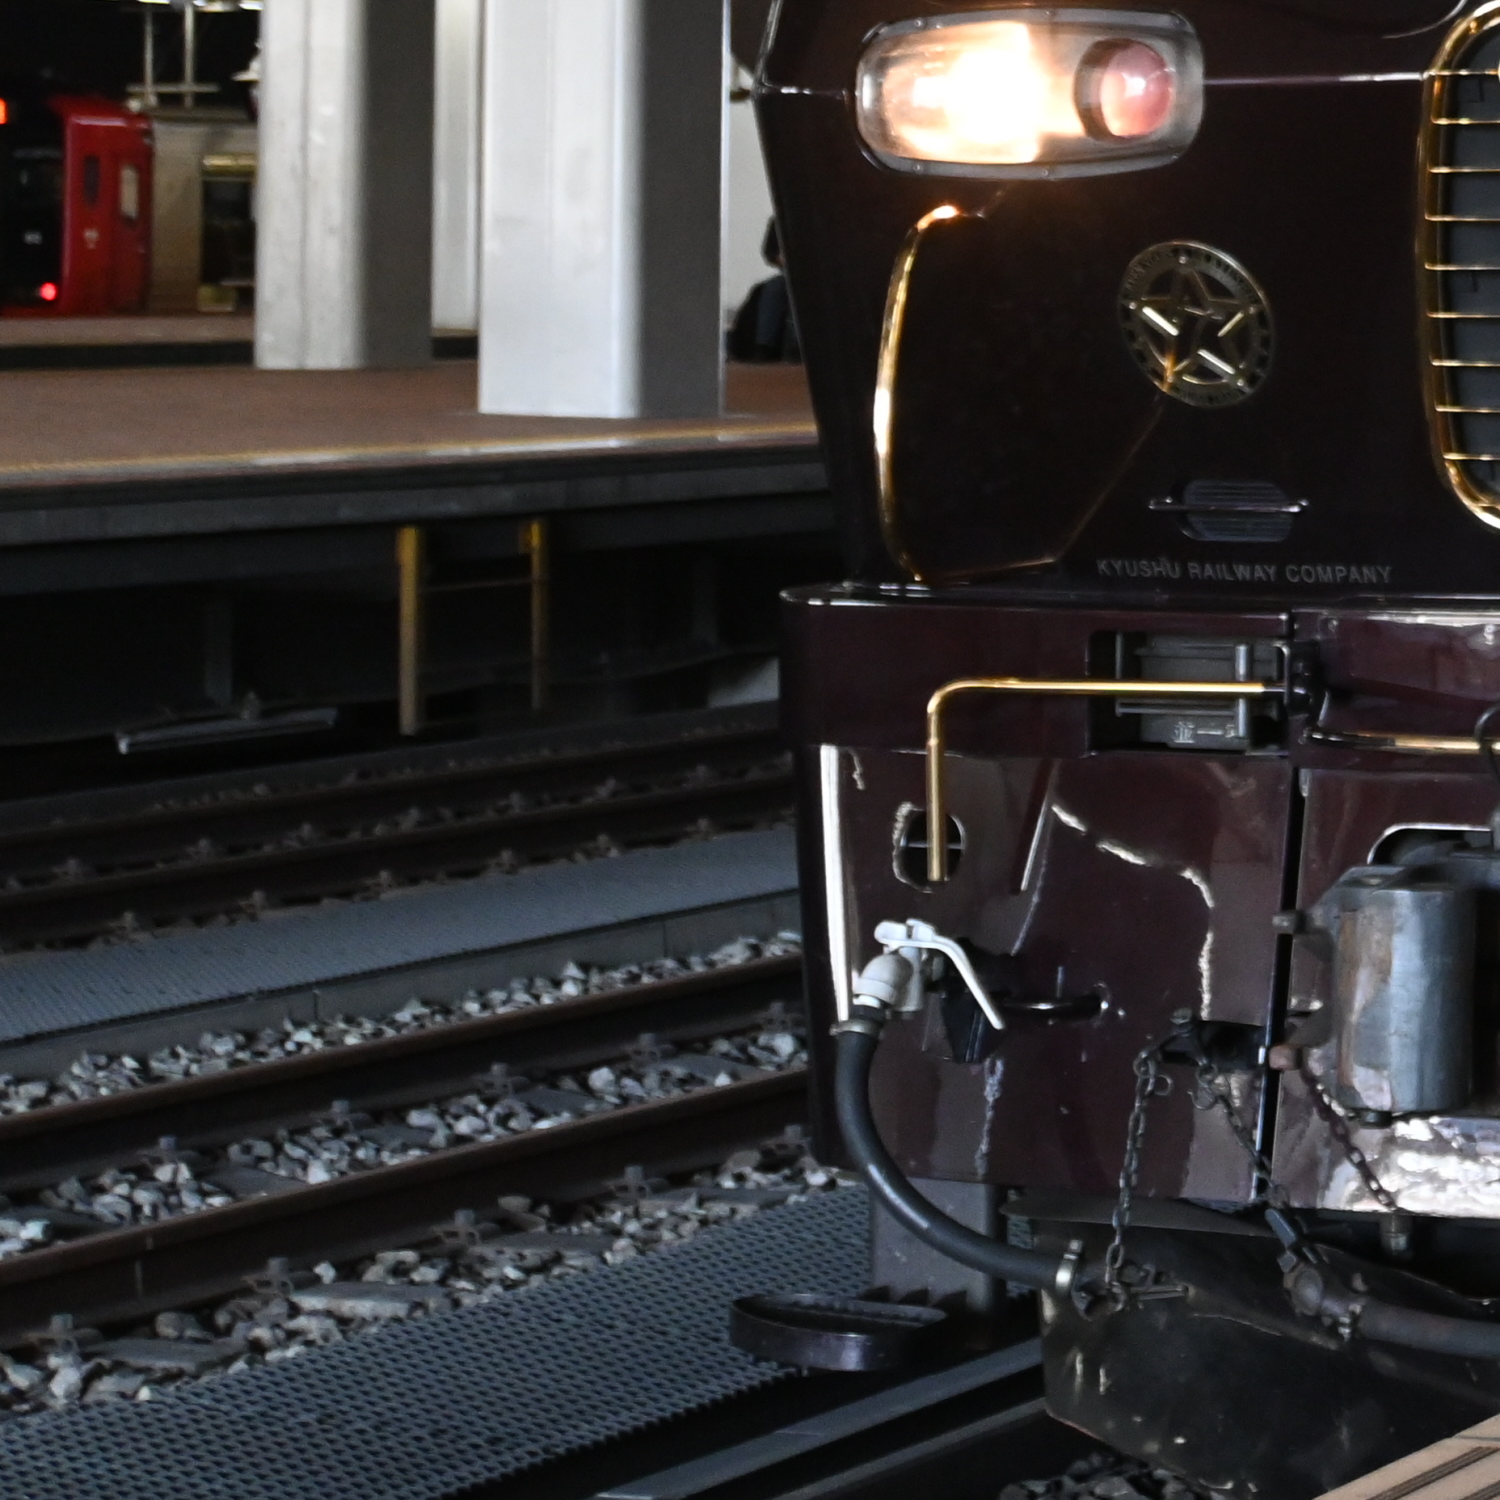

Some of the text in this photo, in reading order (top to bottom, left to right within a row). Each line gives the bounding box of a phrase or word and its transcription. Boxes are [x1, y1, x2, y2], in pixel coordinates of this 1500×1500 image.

[1096, 558, 1392, 584] KYUSHU RAILWAY COMPANY
